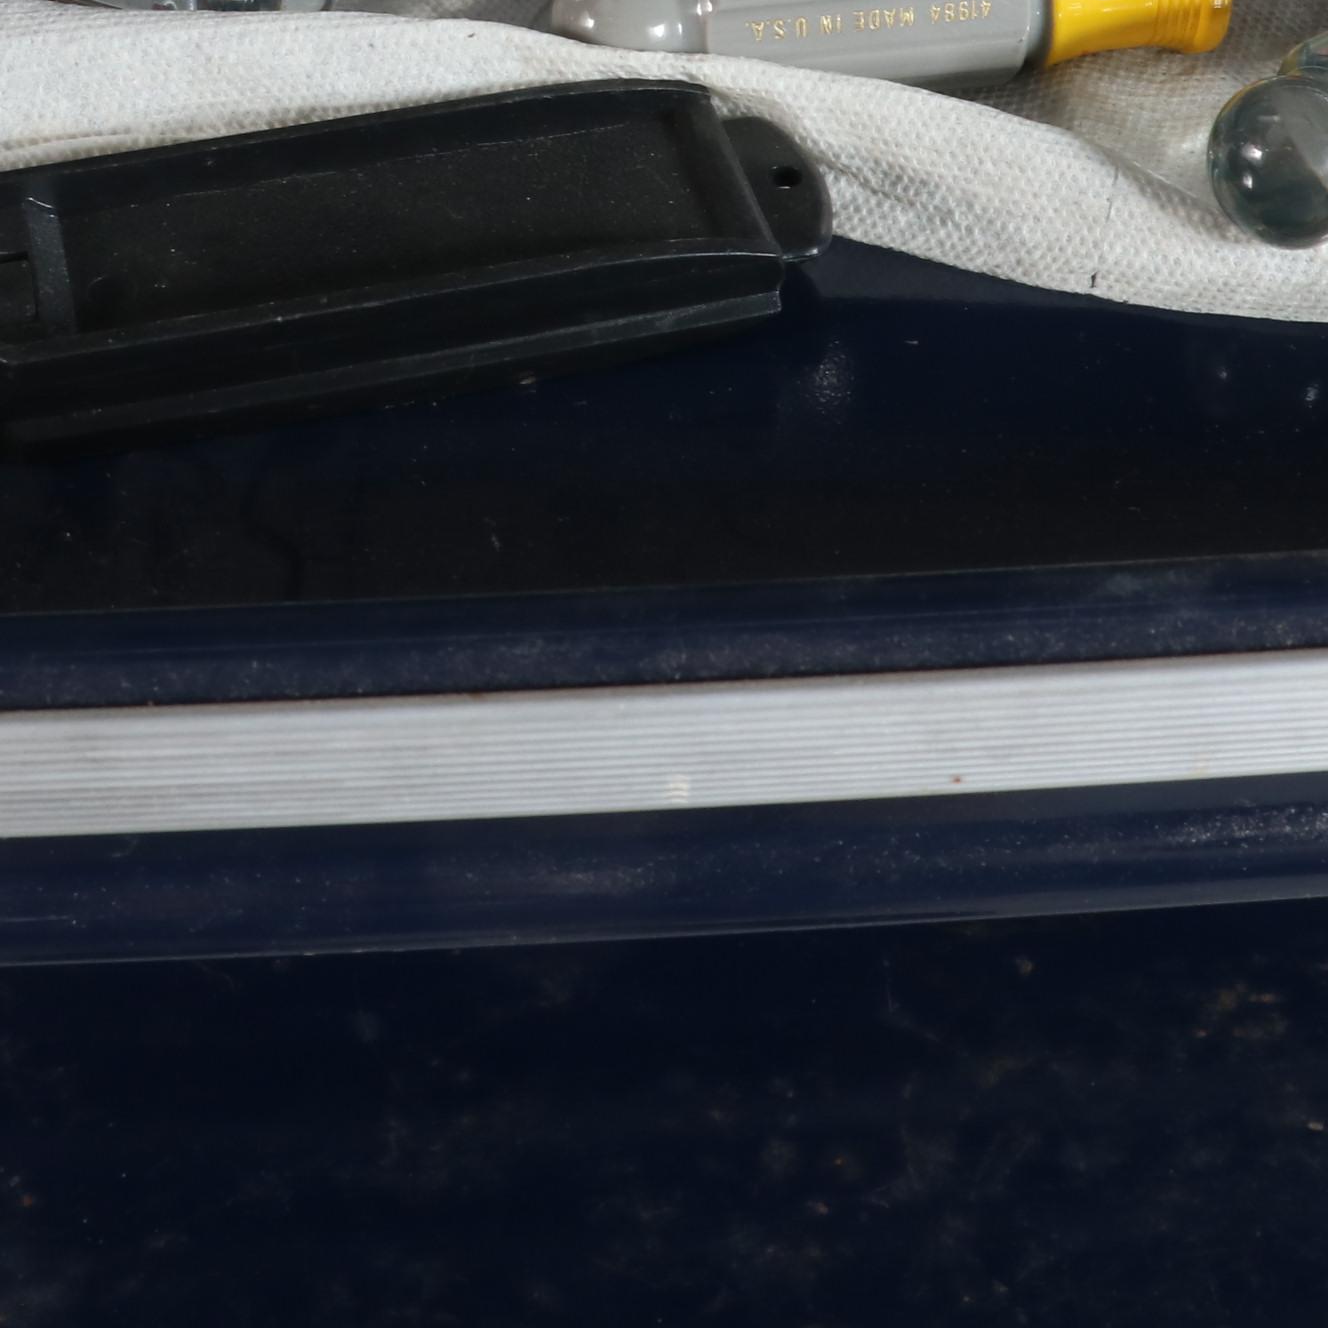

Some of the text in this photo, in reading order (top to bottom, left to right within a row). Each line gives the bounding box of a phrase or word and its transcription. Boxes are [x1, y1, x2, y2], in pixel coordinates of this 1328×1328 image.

[743, 0, 993, 43] 41984 MADE IN U.S.A.
